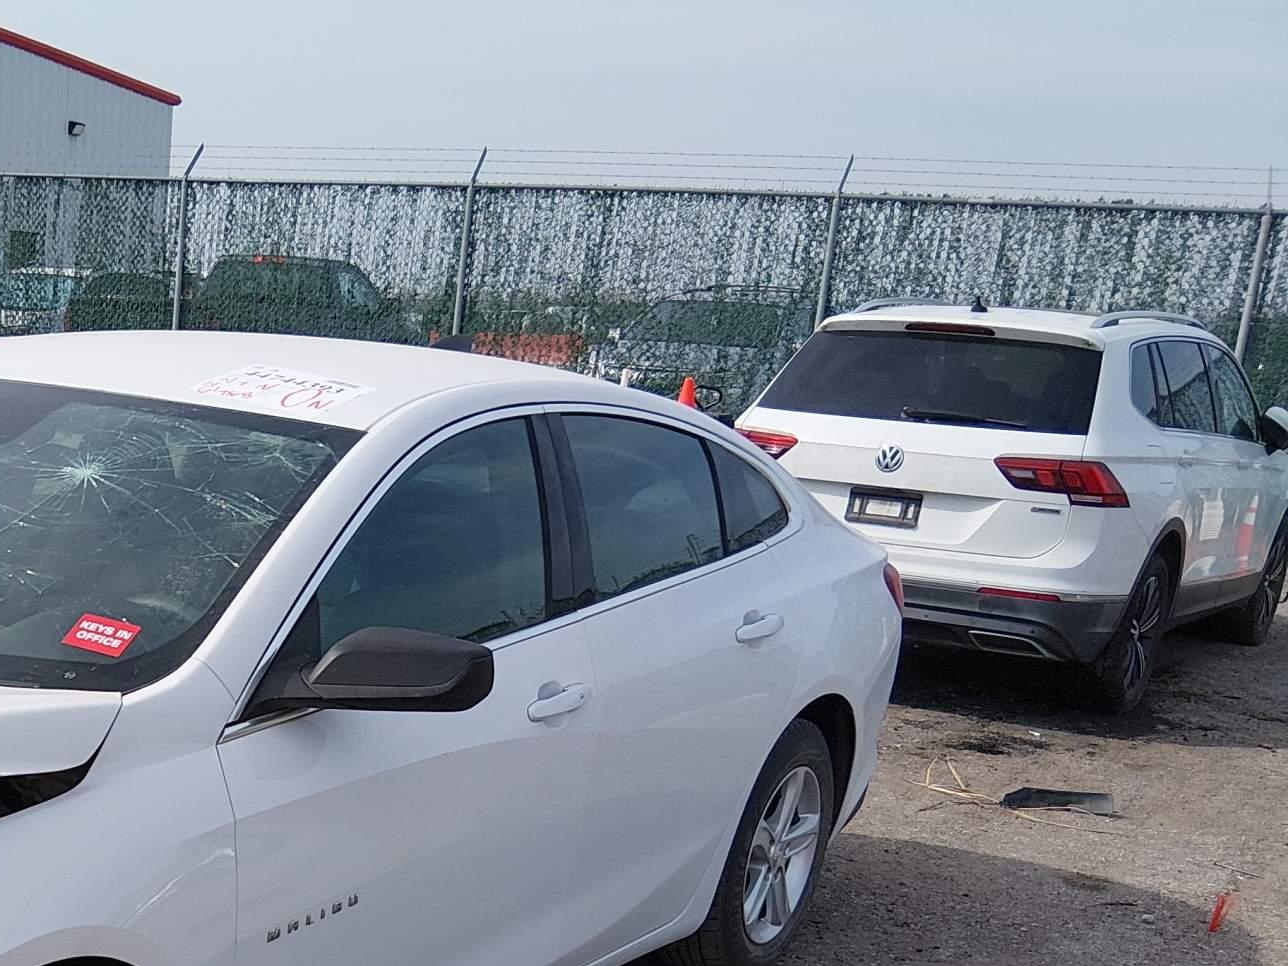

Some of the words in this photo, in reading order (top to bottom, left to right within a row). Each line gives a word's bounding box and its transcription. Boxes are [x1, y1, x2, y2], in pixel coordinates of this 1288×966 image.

[75, 630, 123, 648] OFFICE
[79, 620, 116, 635] KEYS
[115, 629, 133, 640] IN
[266, 893, 359, 943] MALIBU
